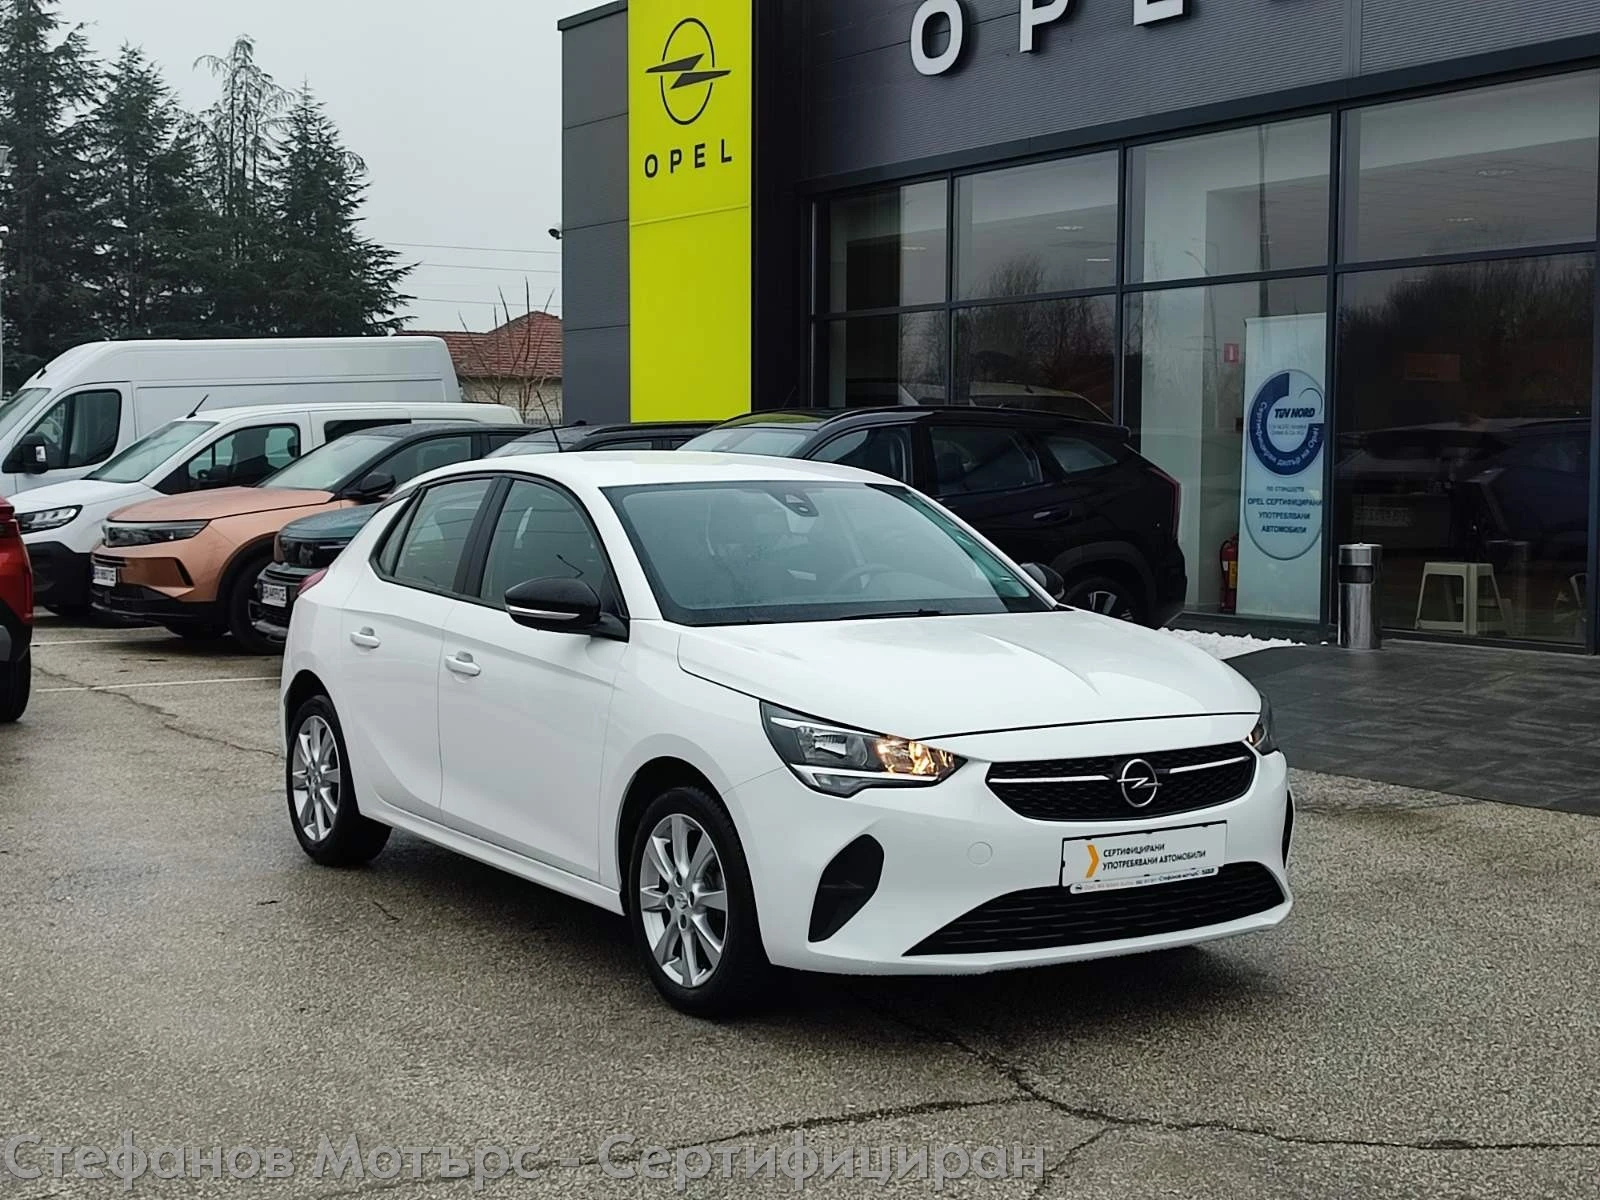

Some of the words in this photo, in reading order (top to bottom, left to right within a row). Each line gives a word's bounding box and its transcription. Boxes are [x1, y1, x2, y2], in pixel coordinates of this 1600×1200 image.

[644, 138, 733, 178] OPEL
[1274, 408, 1291, 419] TÜV
[1290, 407, 1316, 418] NORD
[1247, 497, 1264, 505] OPEL
[1261, 525, 1307, 533] АВТОМОБИЛИ
[1103, 843, 1165, 858] СЕРТИФИЦИРАНИ
[1102, 857, 1158, 871] УПОТРЕБЯВАНИ
[1158, 850, 1206, 864] АВТОМОБИЛИ
